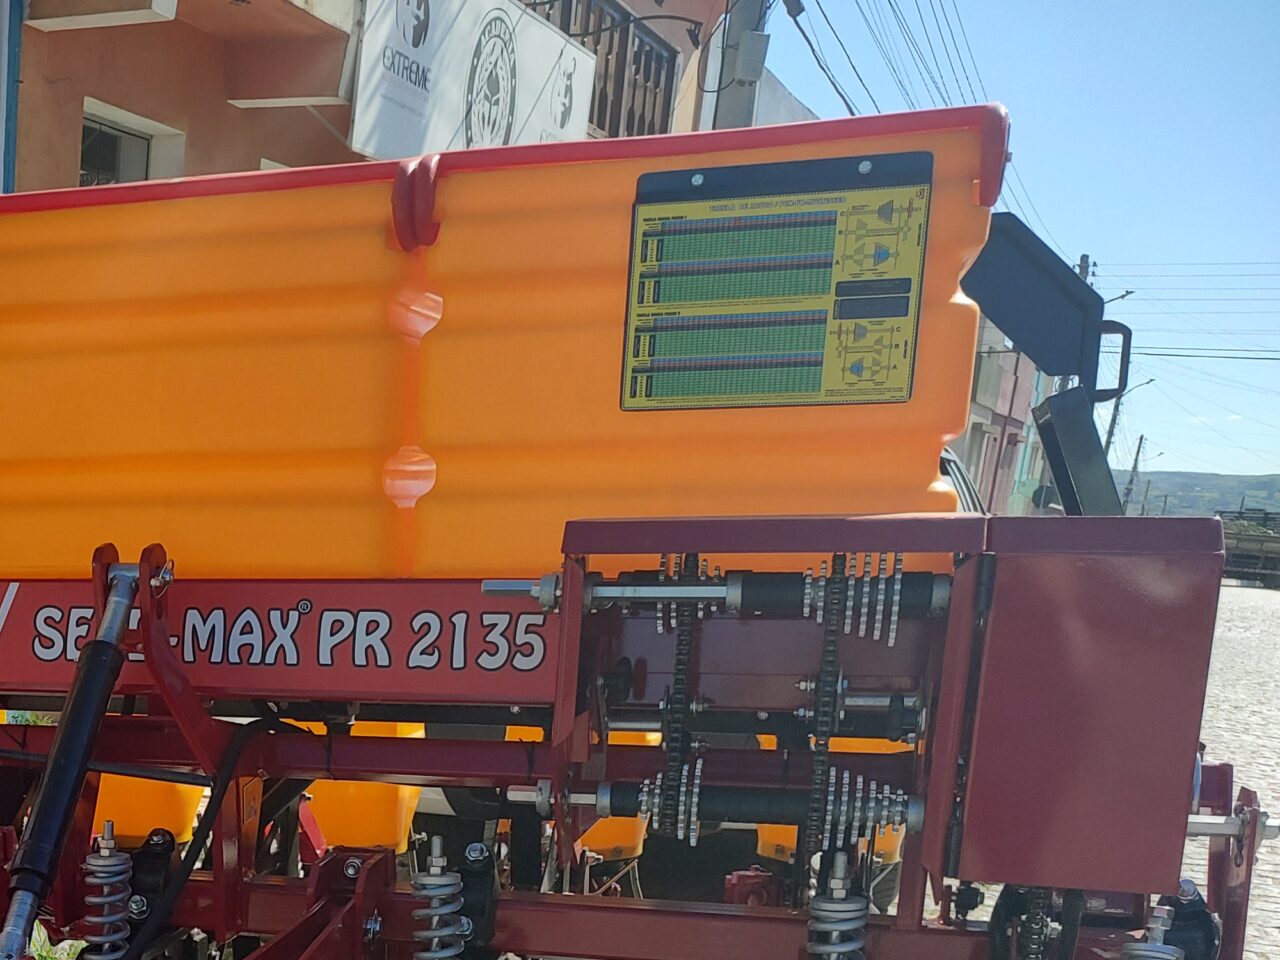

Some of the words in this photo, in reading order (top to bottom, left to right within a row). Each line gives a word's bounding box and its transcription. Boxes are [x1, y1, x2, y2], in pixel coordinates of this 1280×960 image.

[382, 45, 432, 93] EXTREME
[318, 608, 392, 667] PR
[407, 610, 546, 672] 2135
